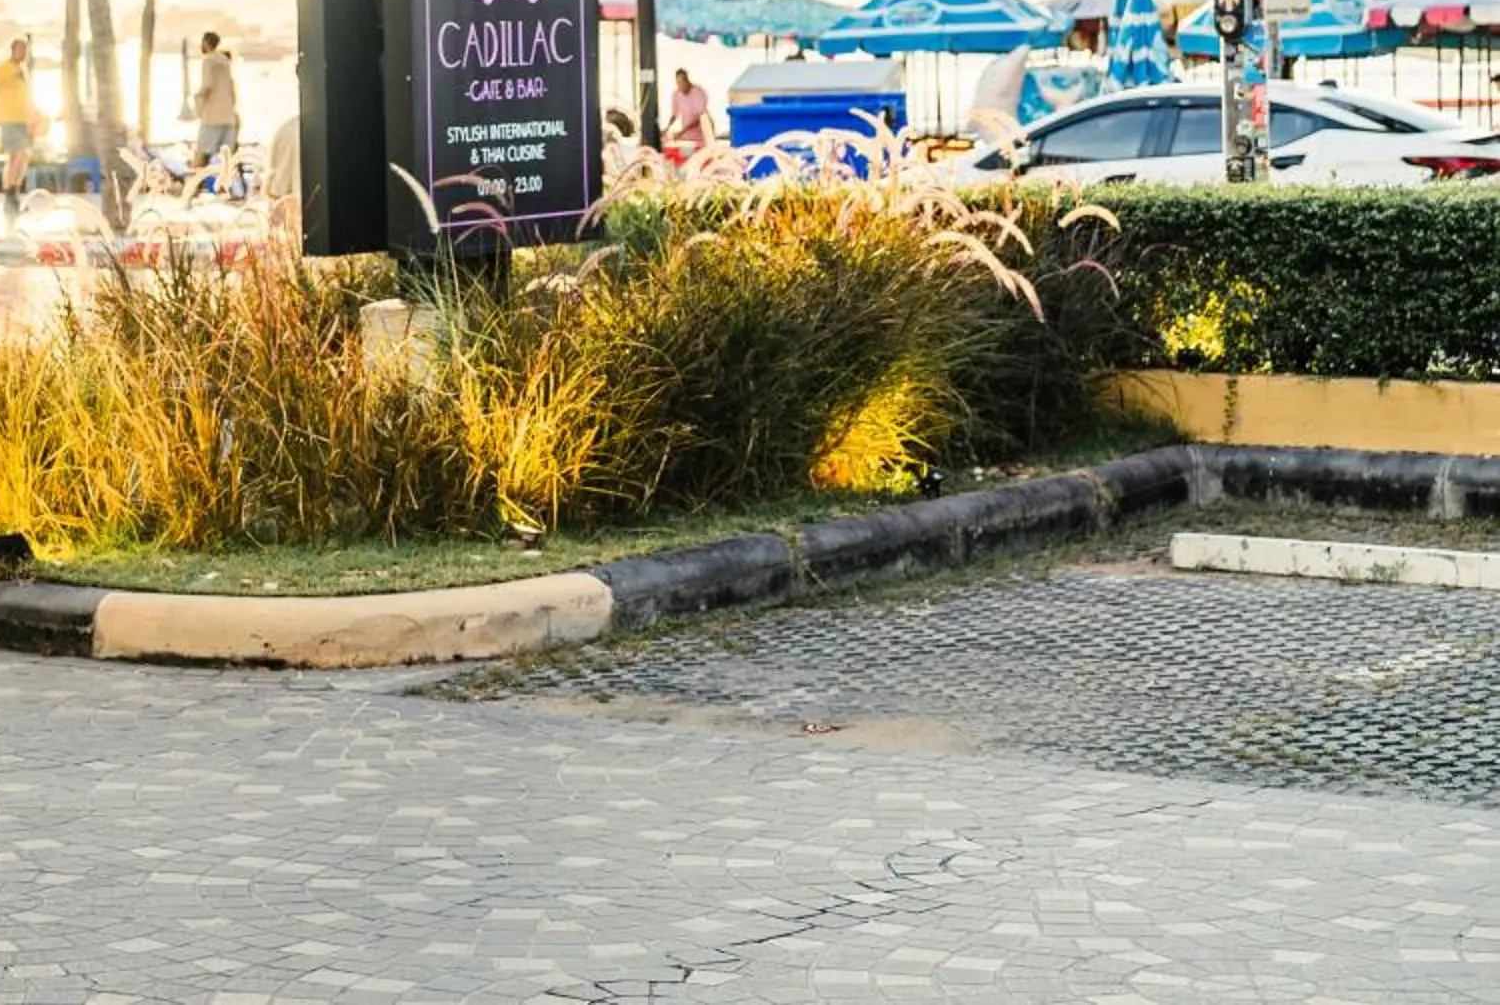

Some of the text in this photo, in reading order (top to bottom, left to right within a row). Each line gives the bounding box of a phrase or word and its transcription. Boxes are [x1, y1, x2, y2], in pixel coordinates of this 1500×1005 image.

[437, 17, 574, 69] CADILLAC
[505, 79, 515, 100] &
[447, 120, 568, 144] STYLISH INTERNATIONAL
[470, 142, 546, 165] & THAI CUISINE
